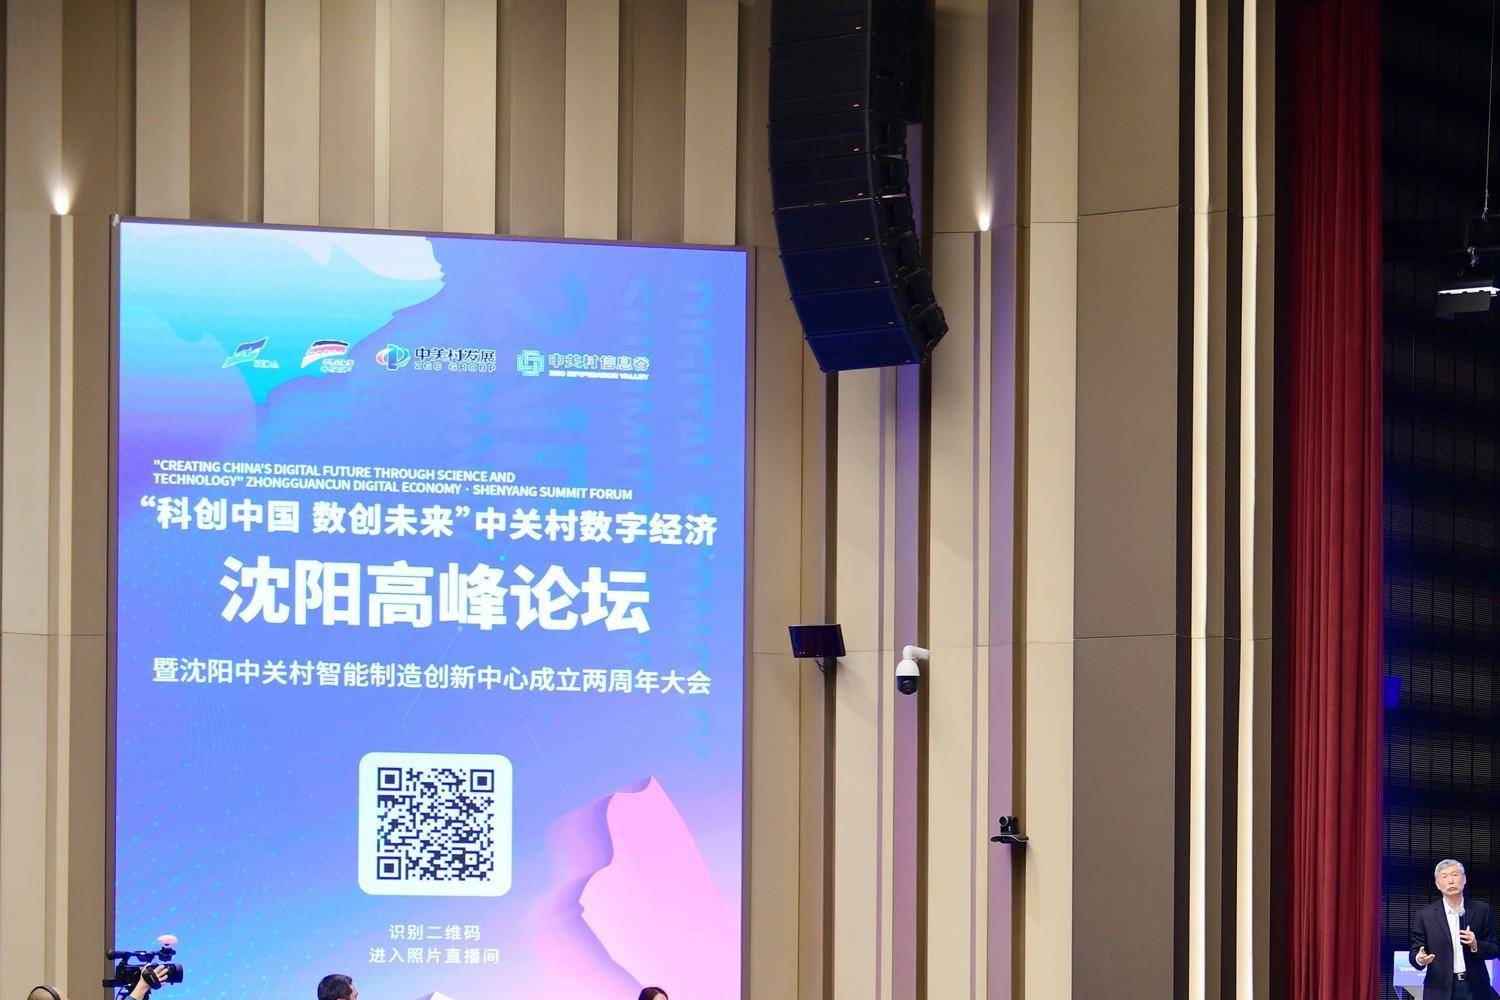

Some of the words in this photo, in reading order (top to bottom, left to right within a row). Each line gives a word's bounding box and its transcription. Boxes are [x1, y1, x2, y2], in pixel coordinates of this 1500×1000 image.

[414, 346, 497, 362] 中关村发展
[549, 353, 650, 371] 中关村信息谷
[449, 362, 497, 373] GROUP
[153, 459, 220, 472] "CREATING
[223, 462, 271, 474] CHINA'S
[274, 464, 320, 476] DIGITAL
[323, 466, 371, 478] FUTURE
[374, 467, 434, 480] THROUGH
[437, 470, 487, 482] SCIENCE
[489, 471, 516, 483] AND
[153, 473, 243, 487] TECHNOLOGY"
[246, 477, 350, 491] ZHONGGUANCUN
[353, 480, 399, 492] DIGITAL
[402, 481, 461, 495] ECONOMY
[473, 485, 538, 497] SHENYANG
[540, 487, 587, 498] SUMMIT
[589, 488, 633, 500] FORUM
[140, 495, 300, 534] “科创中国
[313, 501, 717, 547] 数创未来”中关村数字经济
[220, 555, 651, 634] 沈阳高峰论坛
[152, 656, 712, 695] 暨沈阳中关村智能制造创新中心成立两周年大会
[389, 923, 482, 942] 识别二维码
[369, 945, 500, 966] 进入照片直播间
